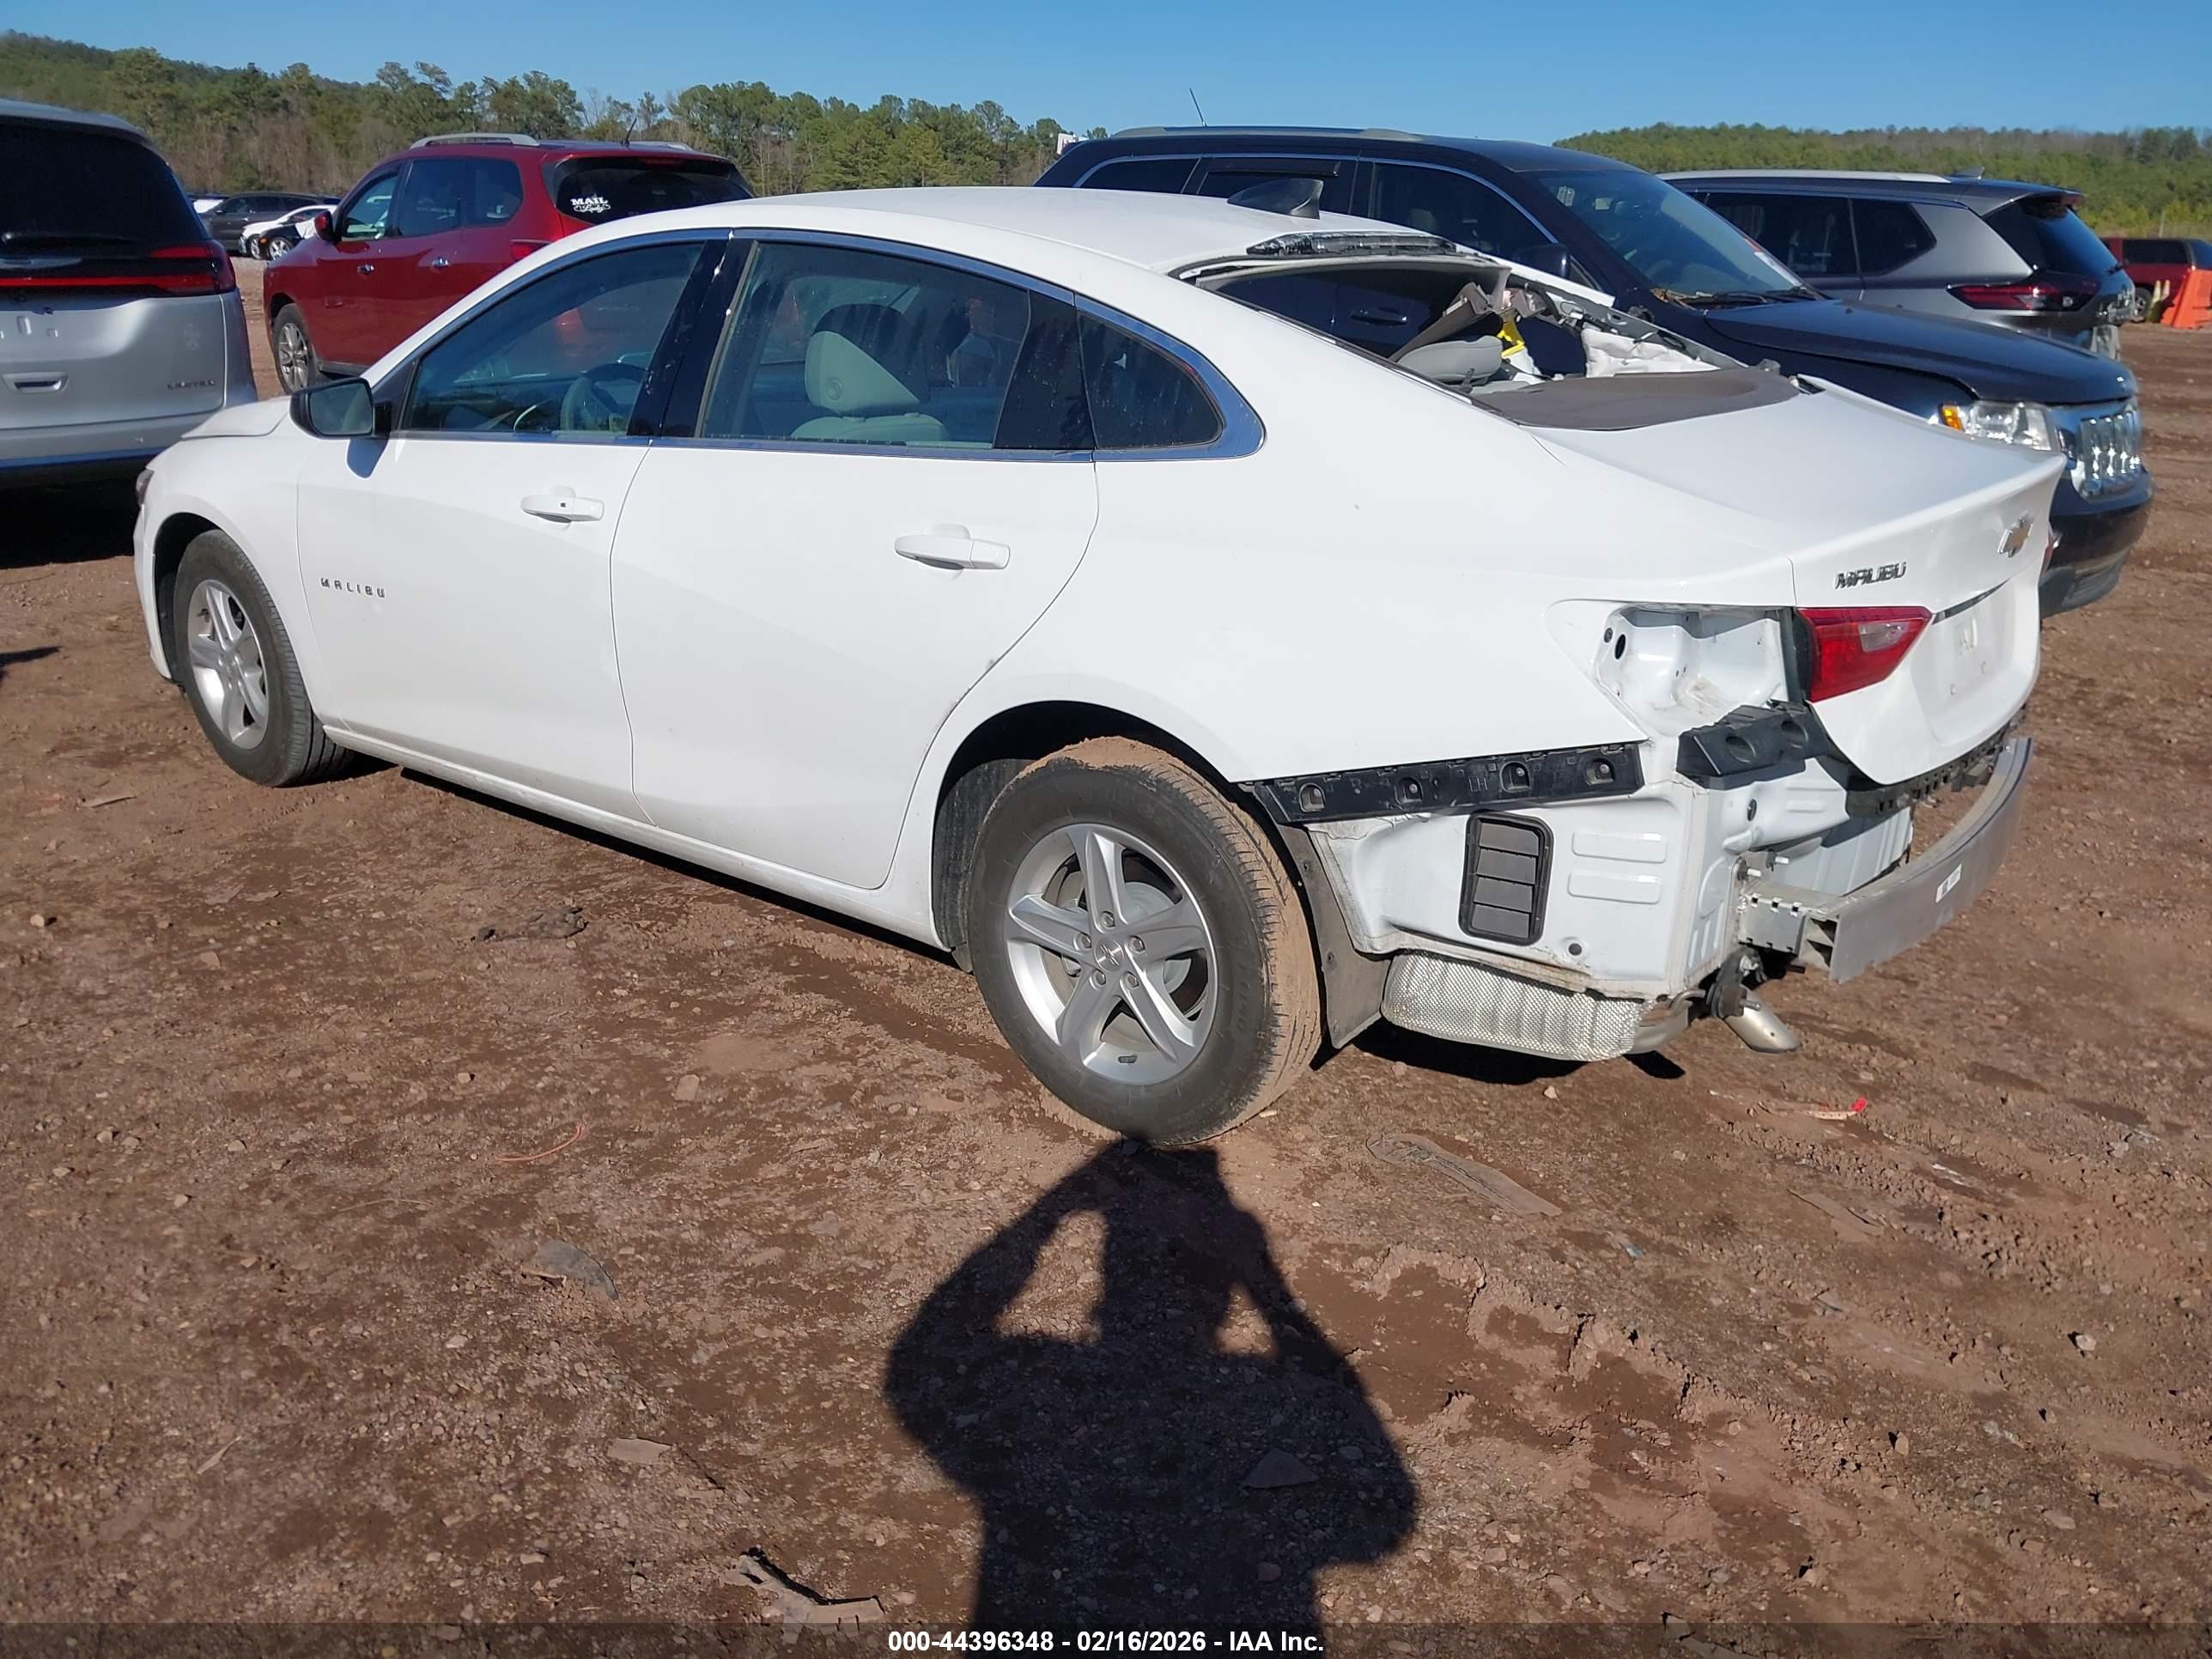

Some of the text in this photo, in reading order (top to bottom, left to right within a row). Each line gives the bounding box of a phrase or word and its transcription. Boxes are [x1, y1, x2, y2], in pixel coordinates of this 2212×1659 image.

[570, 197, 608, 205] MAIL
[1835, 562, 1907, 589] MALIBU
[320, 577, 386, 598] MALIBU
